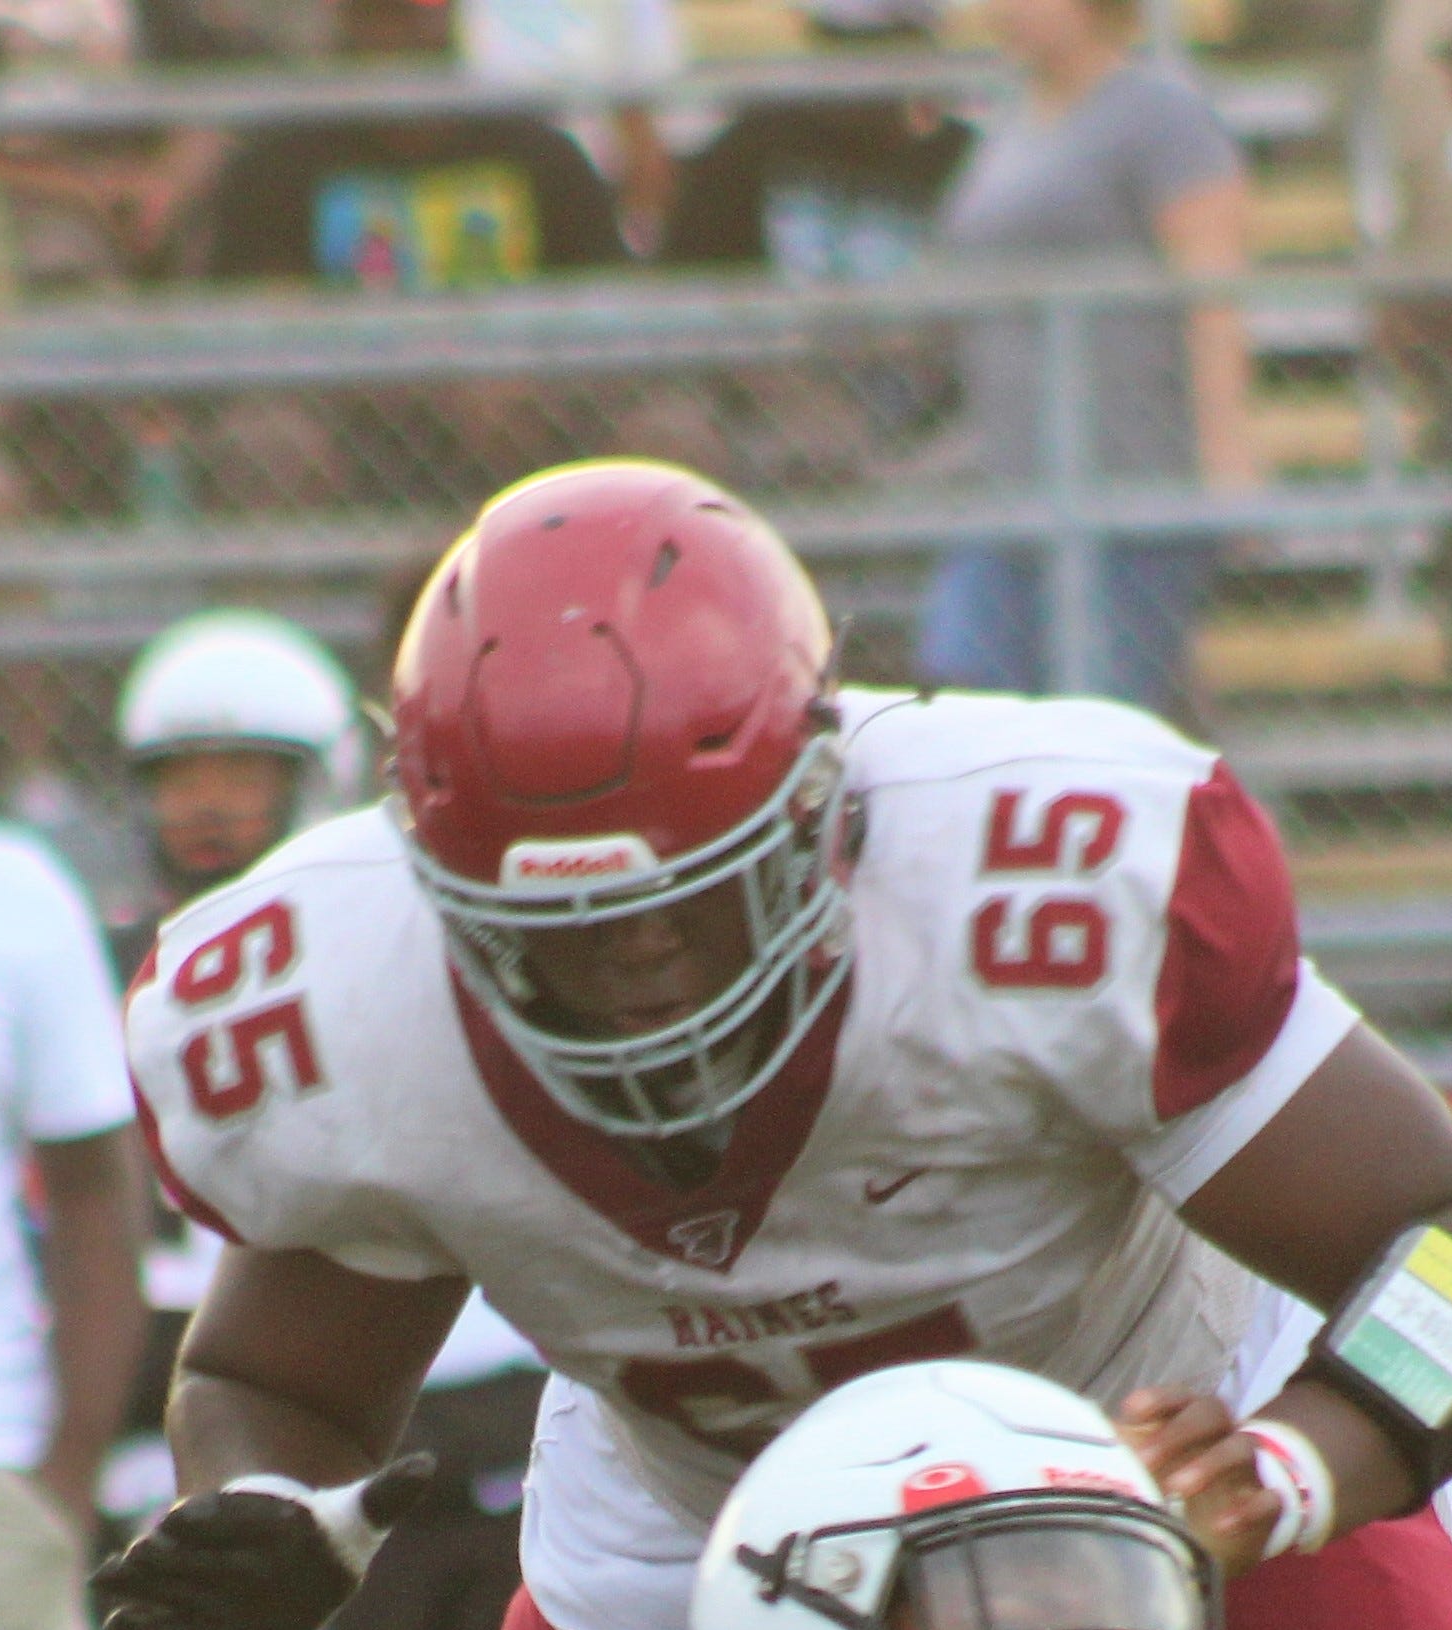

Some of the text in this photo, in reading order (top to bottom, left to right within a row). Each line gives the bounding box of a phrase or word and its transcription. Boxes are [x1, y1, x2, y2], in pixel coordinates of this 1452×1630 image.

[966, 788, 1130, 991] 65
[168, 899, 327, 1127] 65
[661, 1279, 859, 1349] RAINES
